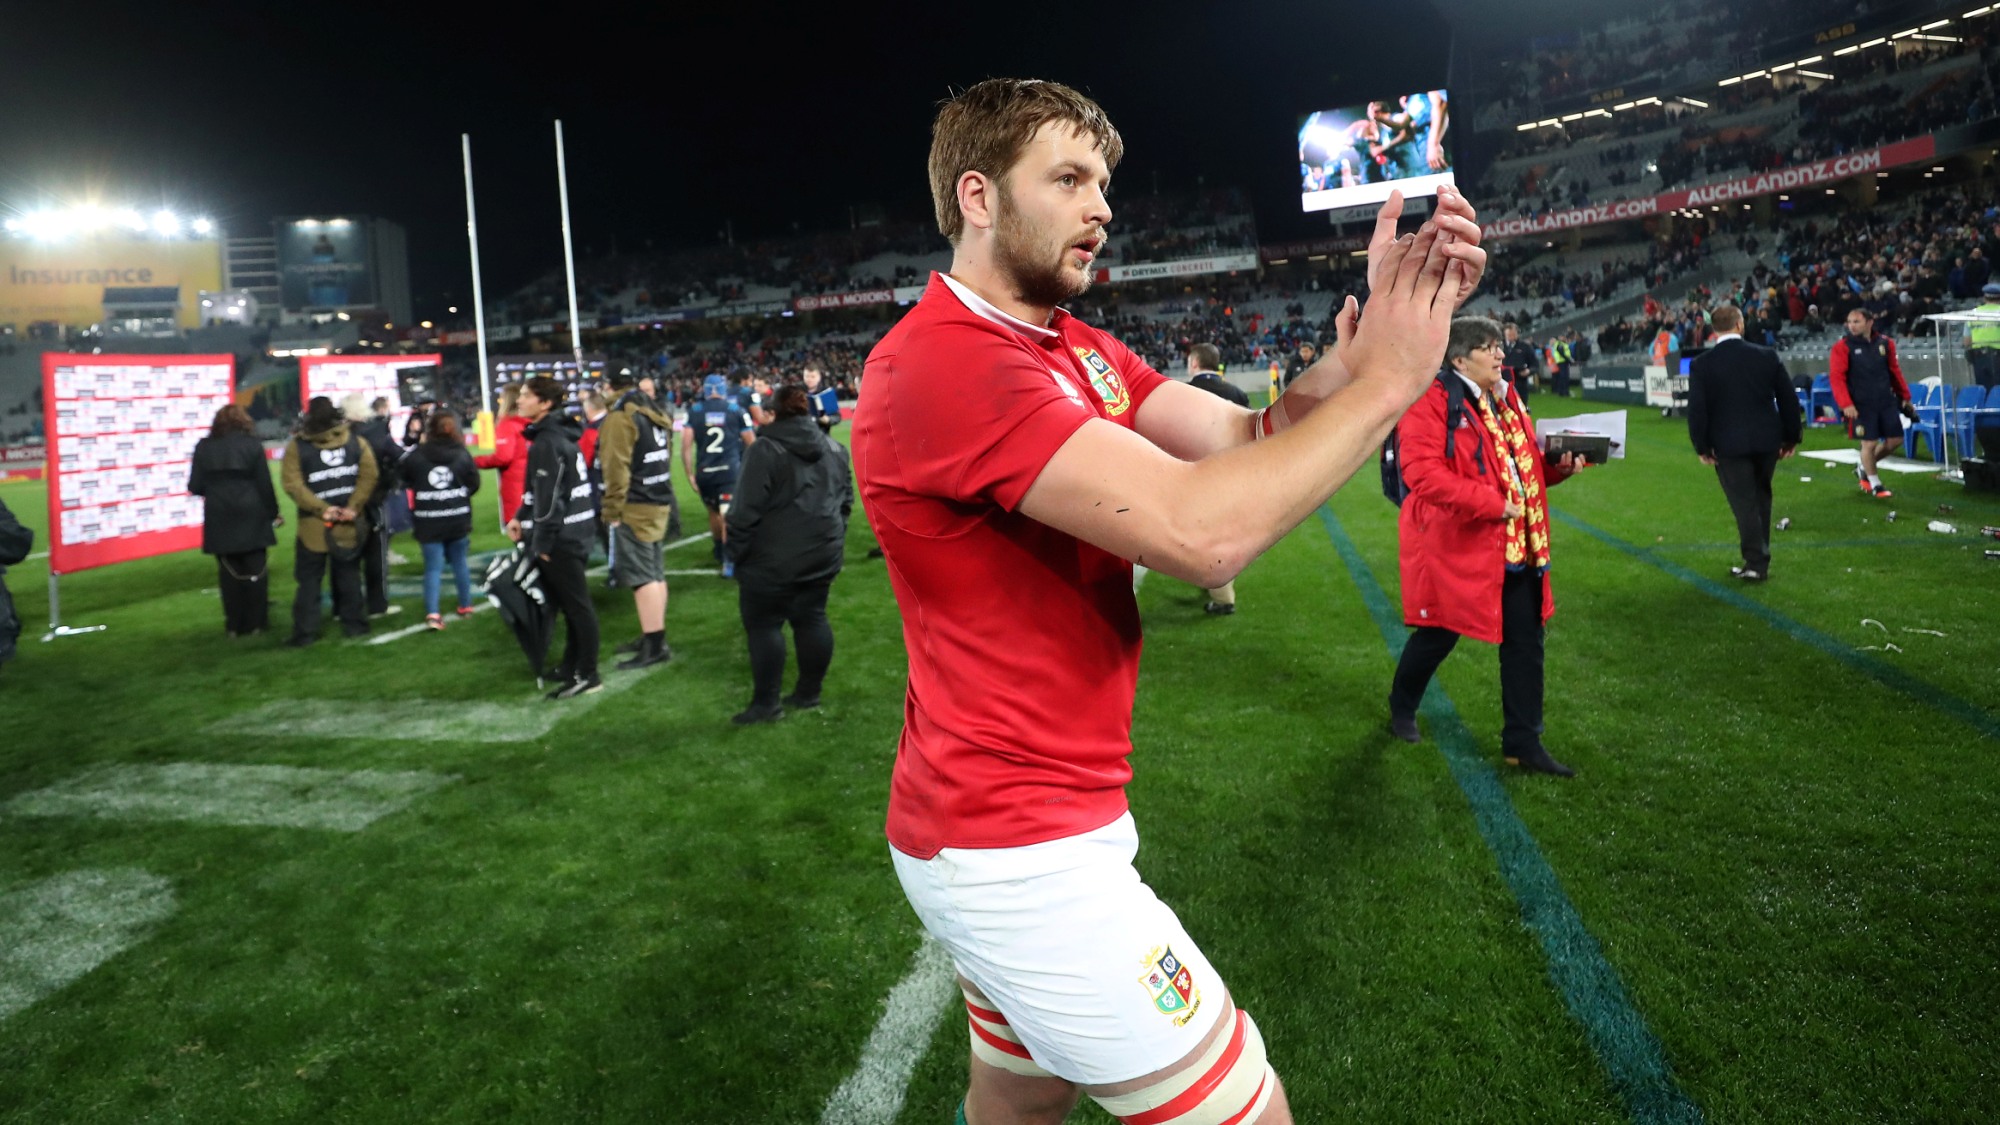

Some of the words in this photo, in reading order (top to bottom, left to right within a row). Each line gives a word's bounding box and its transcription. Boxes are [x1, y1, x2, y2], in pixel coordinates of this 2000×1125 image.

[1815, 23, 1856, 44] ASB
[9, 264, 153, 284] Insurance
[1131, 266, 1168, 277] DRYMIX
[1170, 262, 1214, 274] CONCRETE
[820, 295, 840, 307] KIA
[842, 290, 892, 305] MOTORS
[706, 426, 725, 454] 2
